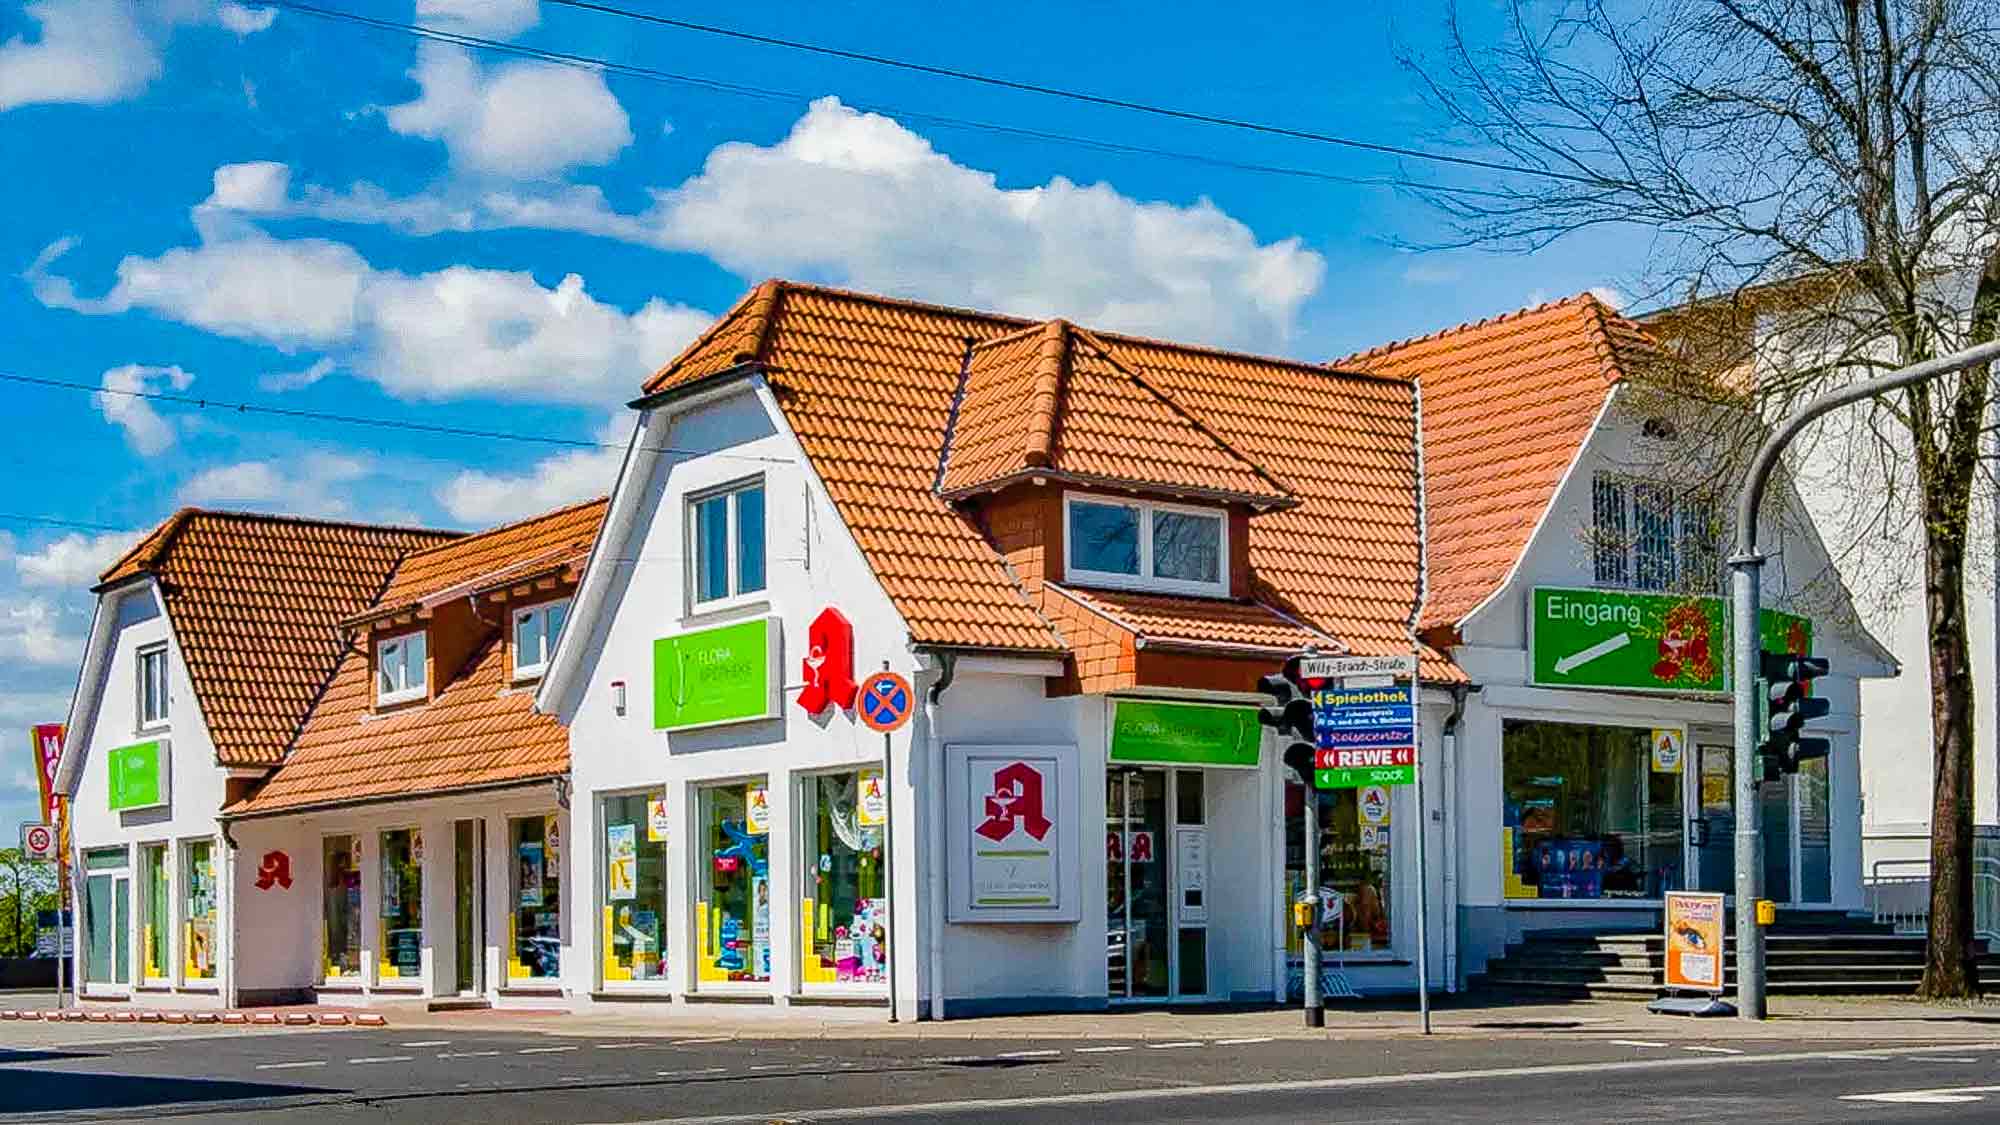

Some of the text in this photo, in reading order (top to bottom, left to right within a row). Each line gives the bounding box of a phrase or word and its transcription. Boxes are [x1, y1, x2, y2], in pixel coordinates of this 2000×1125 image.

[1546, 595, 1641, 628] Eingang
[1324, 690, 1409, 706] Spielothek
[1338, 748, 1393, 767] REWE
